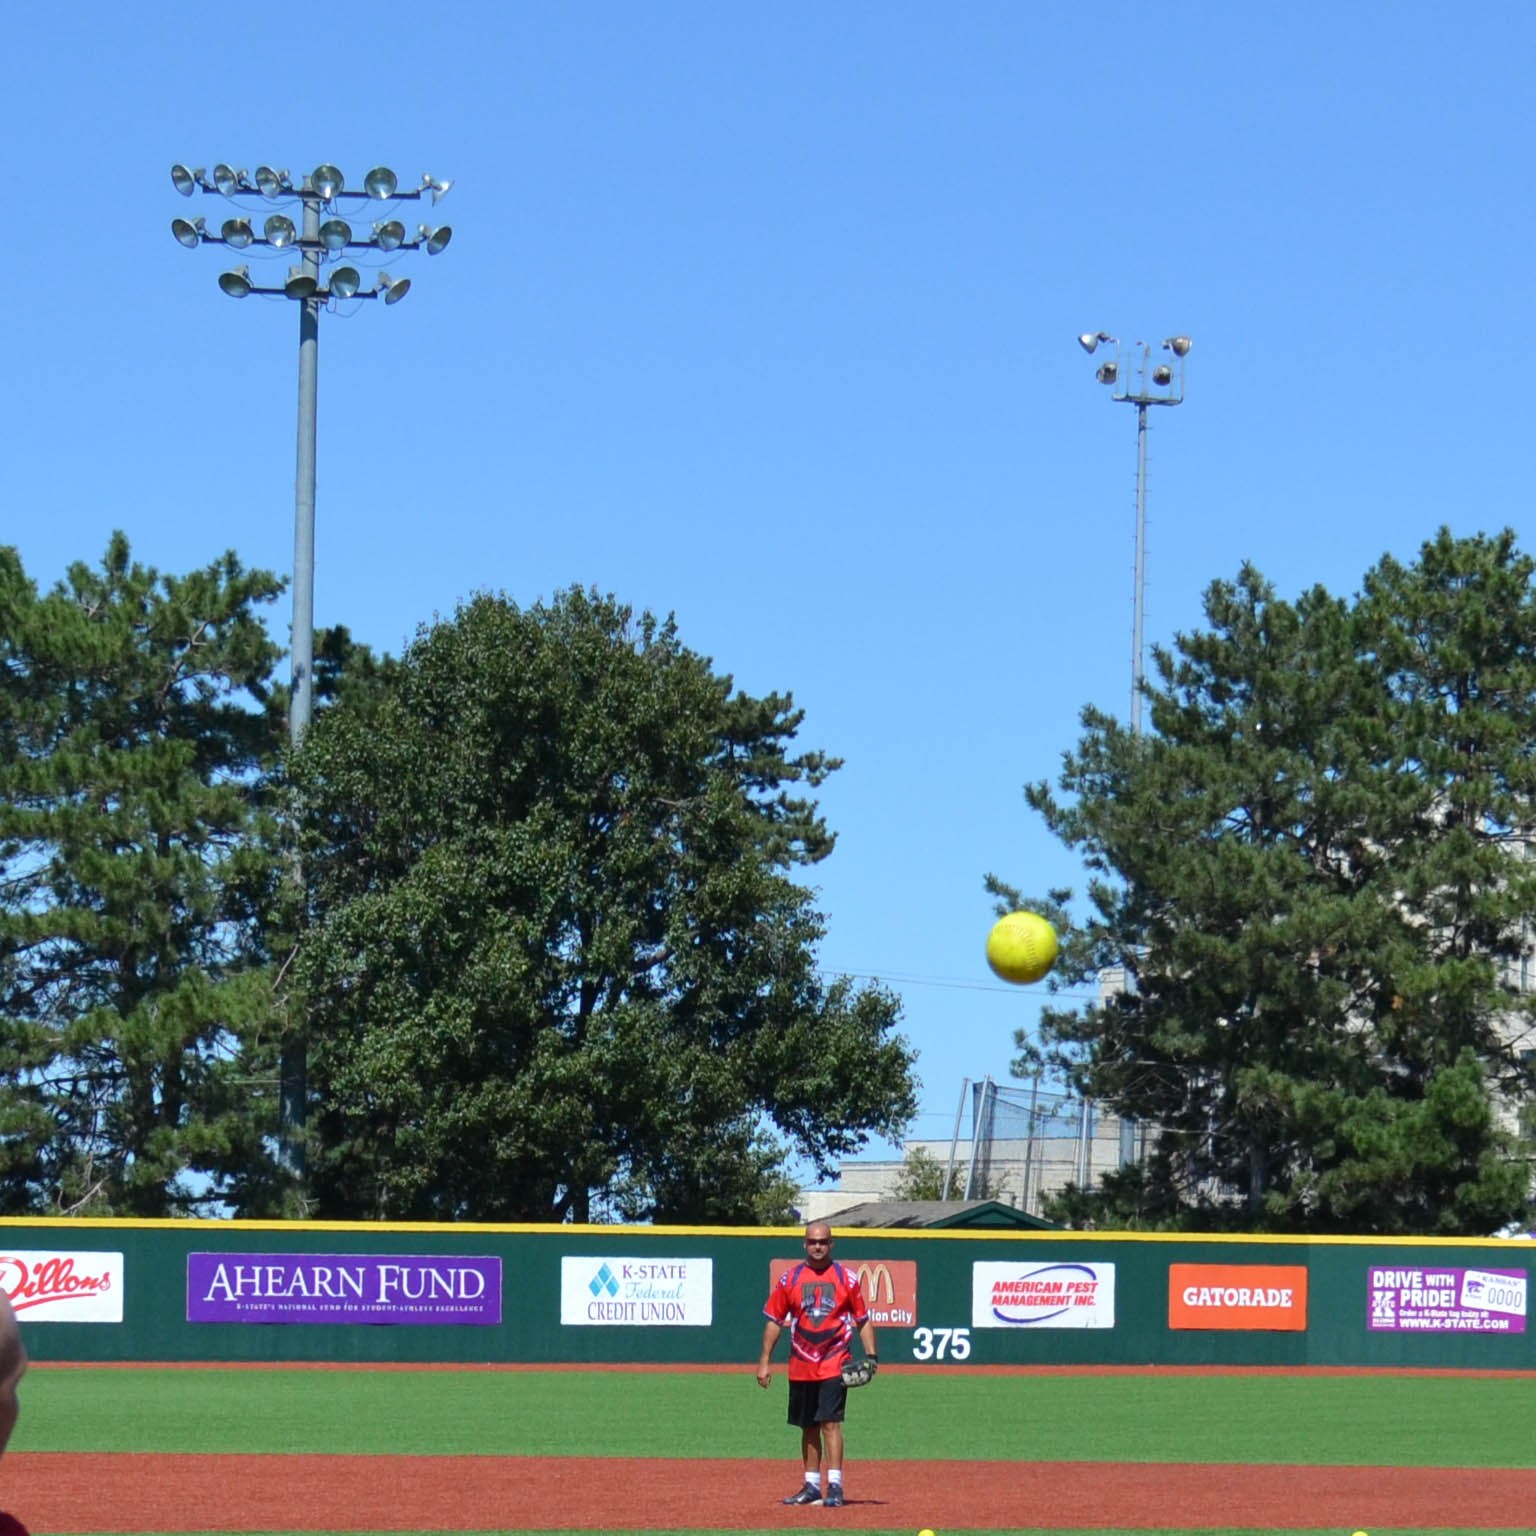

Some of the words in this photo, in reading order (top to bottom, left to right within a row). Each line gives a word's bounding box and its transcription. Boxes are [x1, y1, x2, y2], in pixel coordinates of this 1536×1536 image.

[622, 1264, 687, 1279] K-STATE
[1373, 1271, 1423, 1288] DRIVE
[1425, 1274, 1455, 1287] WITH
[203, 1263, 366, 1302] AHEARN
[625, 1282, 684, 1299] Federal
[992, 1281, 1063, 1293] AMERICAN
[1066, 1282, 1099, 1293] PEST
[992, 1295, 1072, 1306] MANAGEMENT
[1073, 1296, 1097, 1306] INC.
[1183, 1286, 1293, 1308] GATORADE
[1399, 1289, 1456, 1308] PRIDE!
[1487, 1287, 1523, 1308] 0000
[587, 1301, 637, 1321] CREDIT
[641, 1302, 686, 1321] UNION
[890, 1311, 913, 1324] City
[1399, 1318, 1510, 1329] WWW.K-STATE.COM
[913, 1327, 971, 1360] 375
